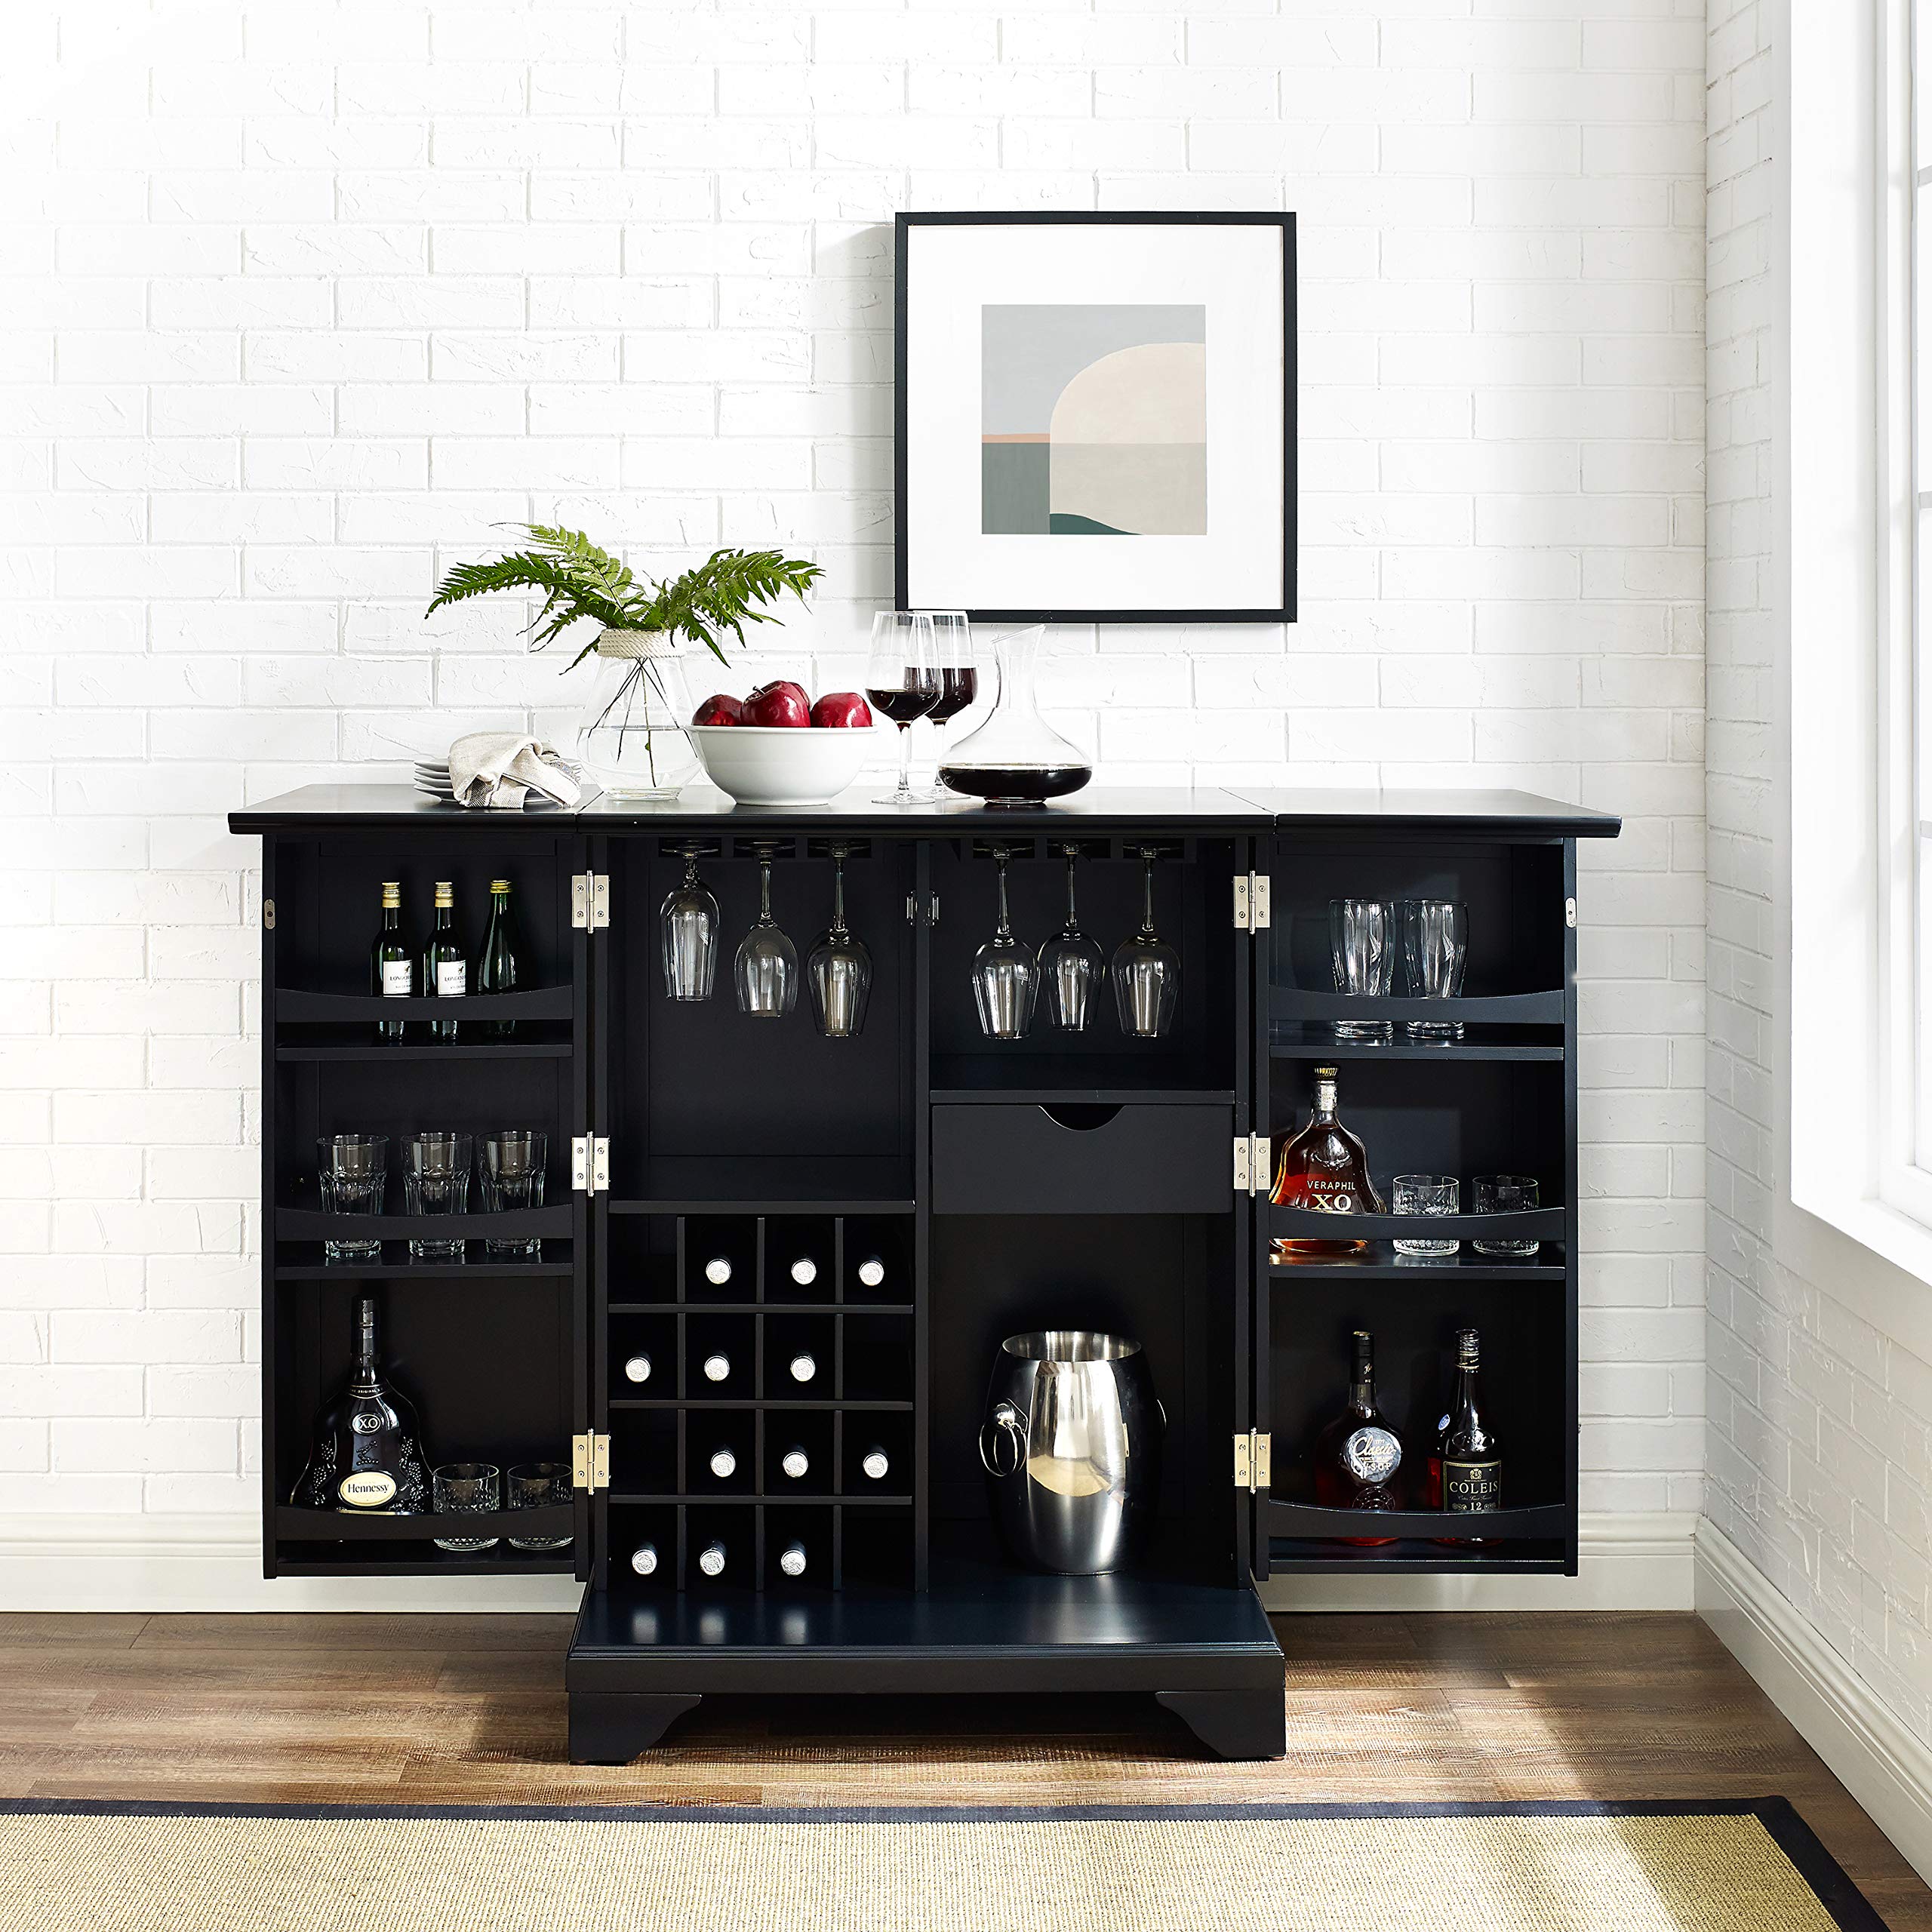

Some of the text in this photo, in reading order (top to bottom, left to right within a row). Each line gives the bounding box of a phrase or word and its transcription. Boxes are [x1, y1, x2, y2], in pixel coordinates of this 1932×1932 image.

[1306, 1180, 1356, 1190] VERAPHIL
[1311, 1193, 1352, 1211] XO
[348, 1484, 389, 1494] Hennessy
[1449, 1481, 1498, 1494] COLEIS
[1470, 1502, 1482, 1511] 12
